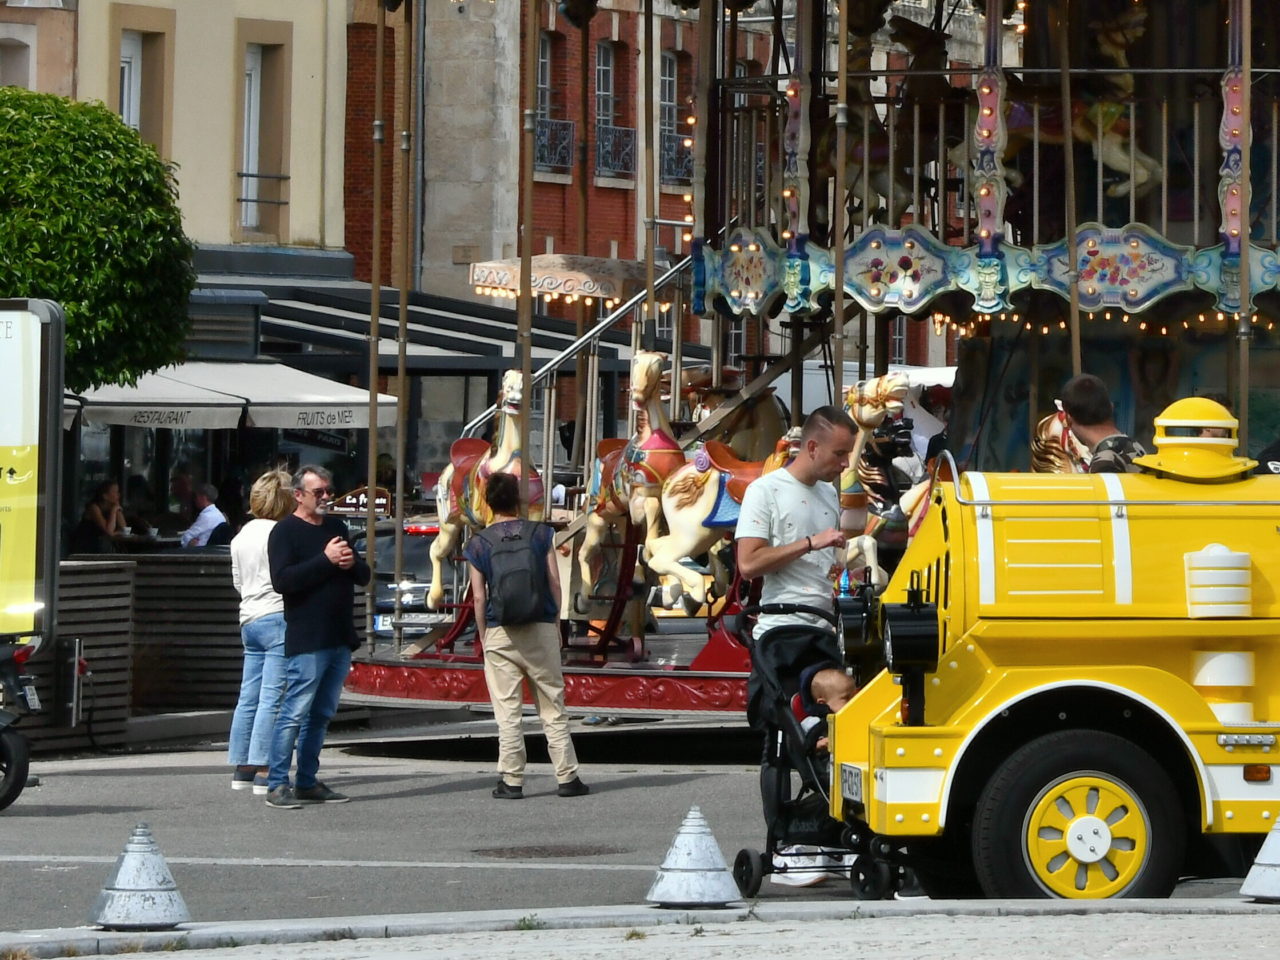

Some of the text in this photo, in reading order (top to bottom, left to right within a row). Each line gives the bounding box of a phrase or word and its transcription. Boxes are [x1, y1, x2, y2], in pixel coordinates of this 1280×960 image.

[131, 410, 191, 424] RESTAURANT
[297, 410, 355, 426] FRUITS de MER
[359, 493, 387, 505] frate
